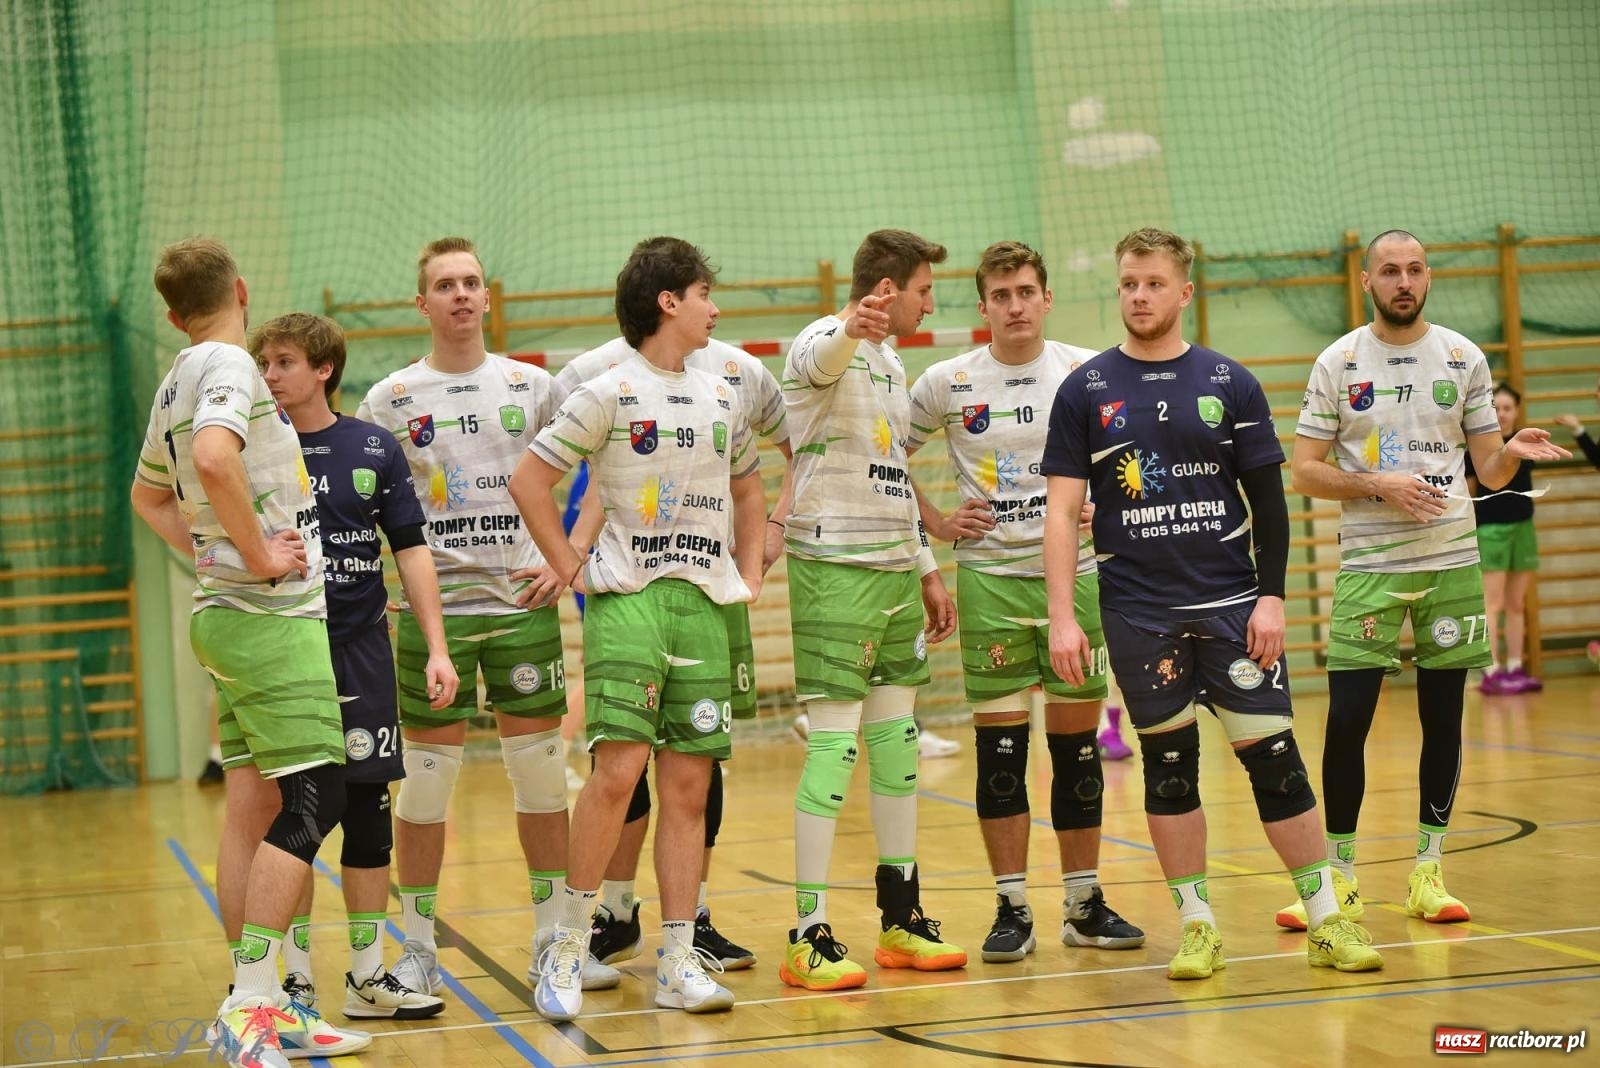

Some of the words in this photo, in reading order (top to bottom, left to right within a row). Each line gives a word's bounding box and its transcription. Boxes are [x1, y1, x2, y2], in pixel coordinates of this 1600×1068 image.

[1395, 384, 1413, 403] 77
[1014, 406, 1034, 424] 10
[1157, 401, 1169, 422] 2
[457, 414, 479, 434] 15
[676, 427, 694, 448] 99
[1408, 440, 1449, 453] GUARD
[1172, 463, 1220, 477] GUARD
[476, 475, 511, 489] GUA
[885, 486, 903, 498] 605
[1018, 510, 1042, 521] 944
[1122, 505, 1177, 526] POMPY
[1181, 500, 1226, 519] CIEPŁA
[329, 530, 376, 544] GUARD
[1141, 525, 1169, 538] 605
[1172, 522, 1199, 534] 944
[444, 537, 468, 549] 605
[472, 535, 497, 546] 944
[675, 533, 721, 558] CIEPŁA
[664, 553, 688, 564] 944
[691, 556, 711, 569] 146
[1463, 614, 1487, 644] 77
[1089, 646, 1105, 676] 10
[546, 660, 565, 691] 15
[1270, 660, 1283, 690] 2
[378, 725, 397, 758] 24
